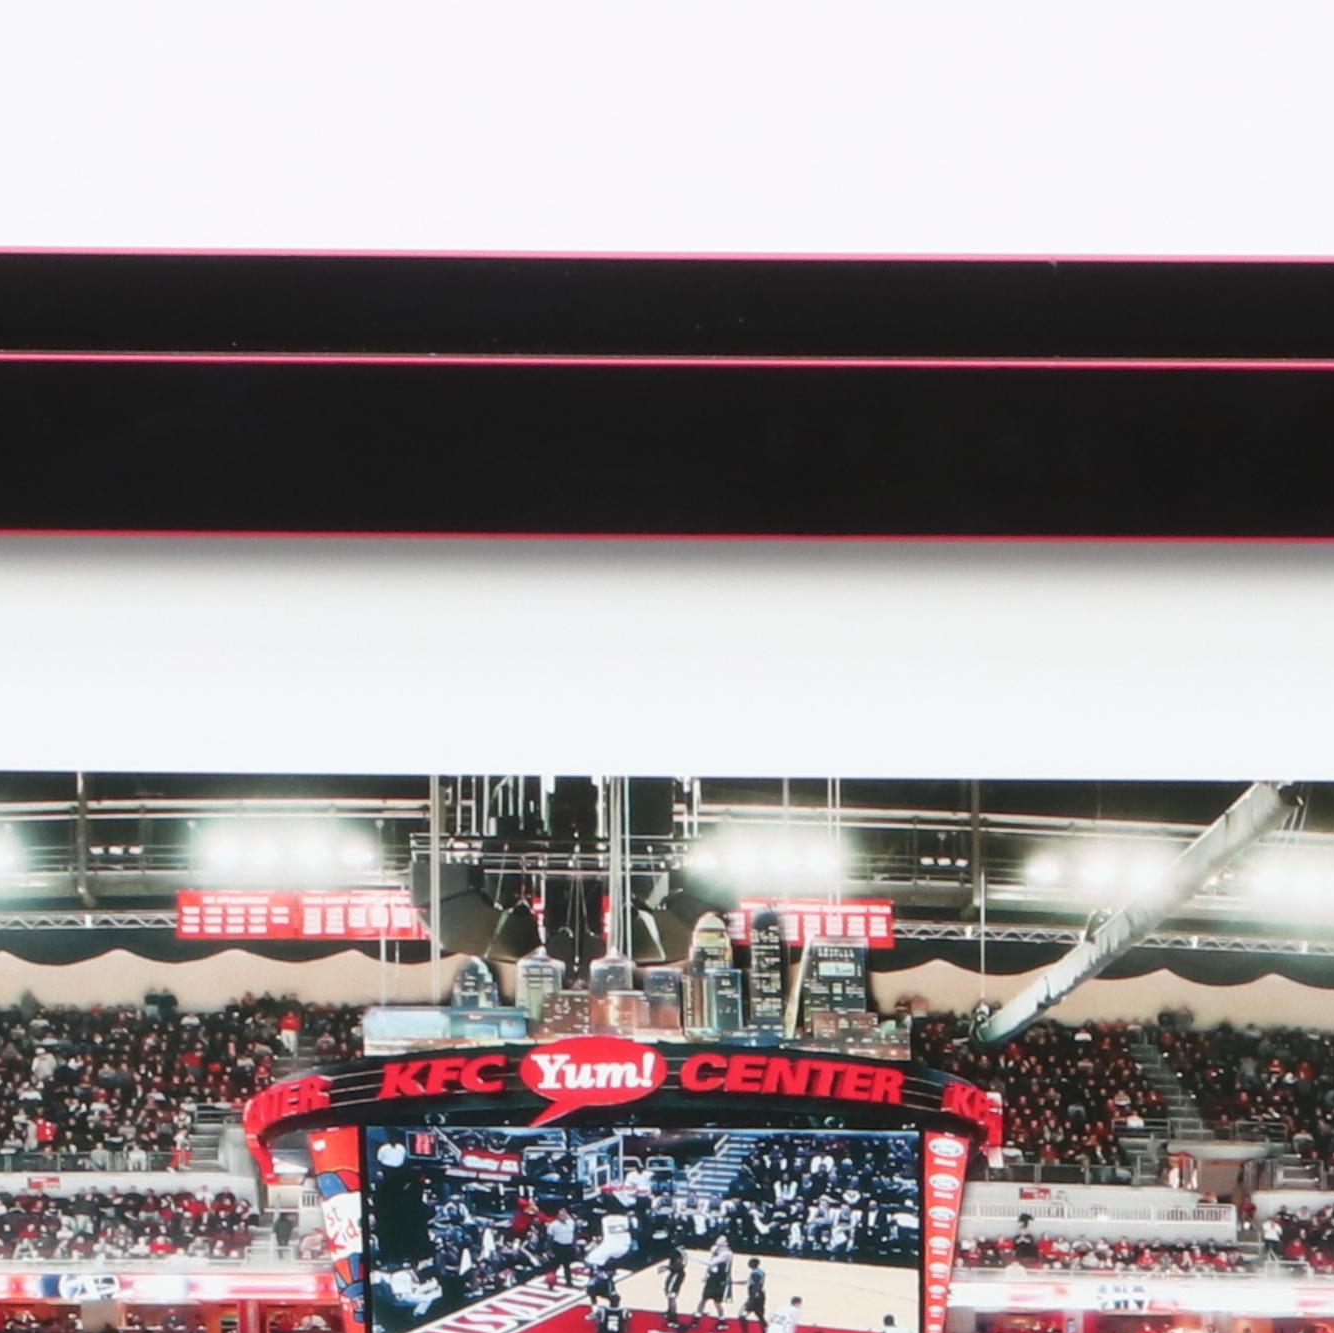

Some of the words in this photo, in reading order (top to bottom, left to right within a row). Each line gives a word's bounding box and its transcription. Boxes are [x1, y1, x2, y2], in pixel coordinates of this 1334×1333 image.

[378, 1054, 509, 1100] KFC
[531, 1051, 655, 1090] Yum!
[679, 1053, 907, 1104] CENTER
